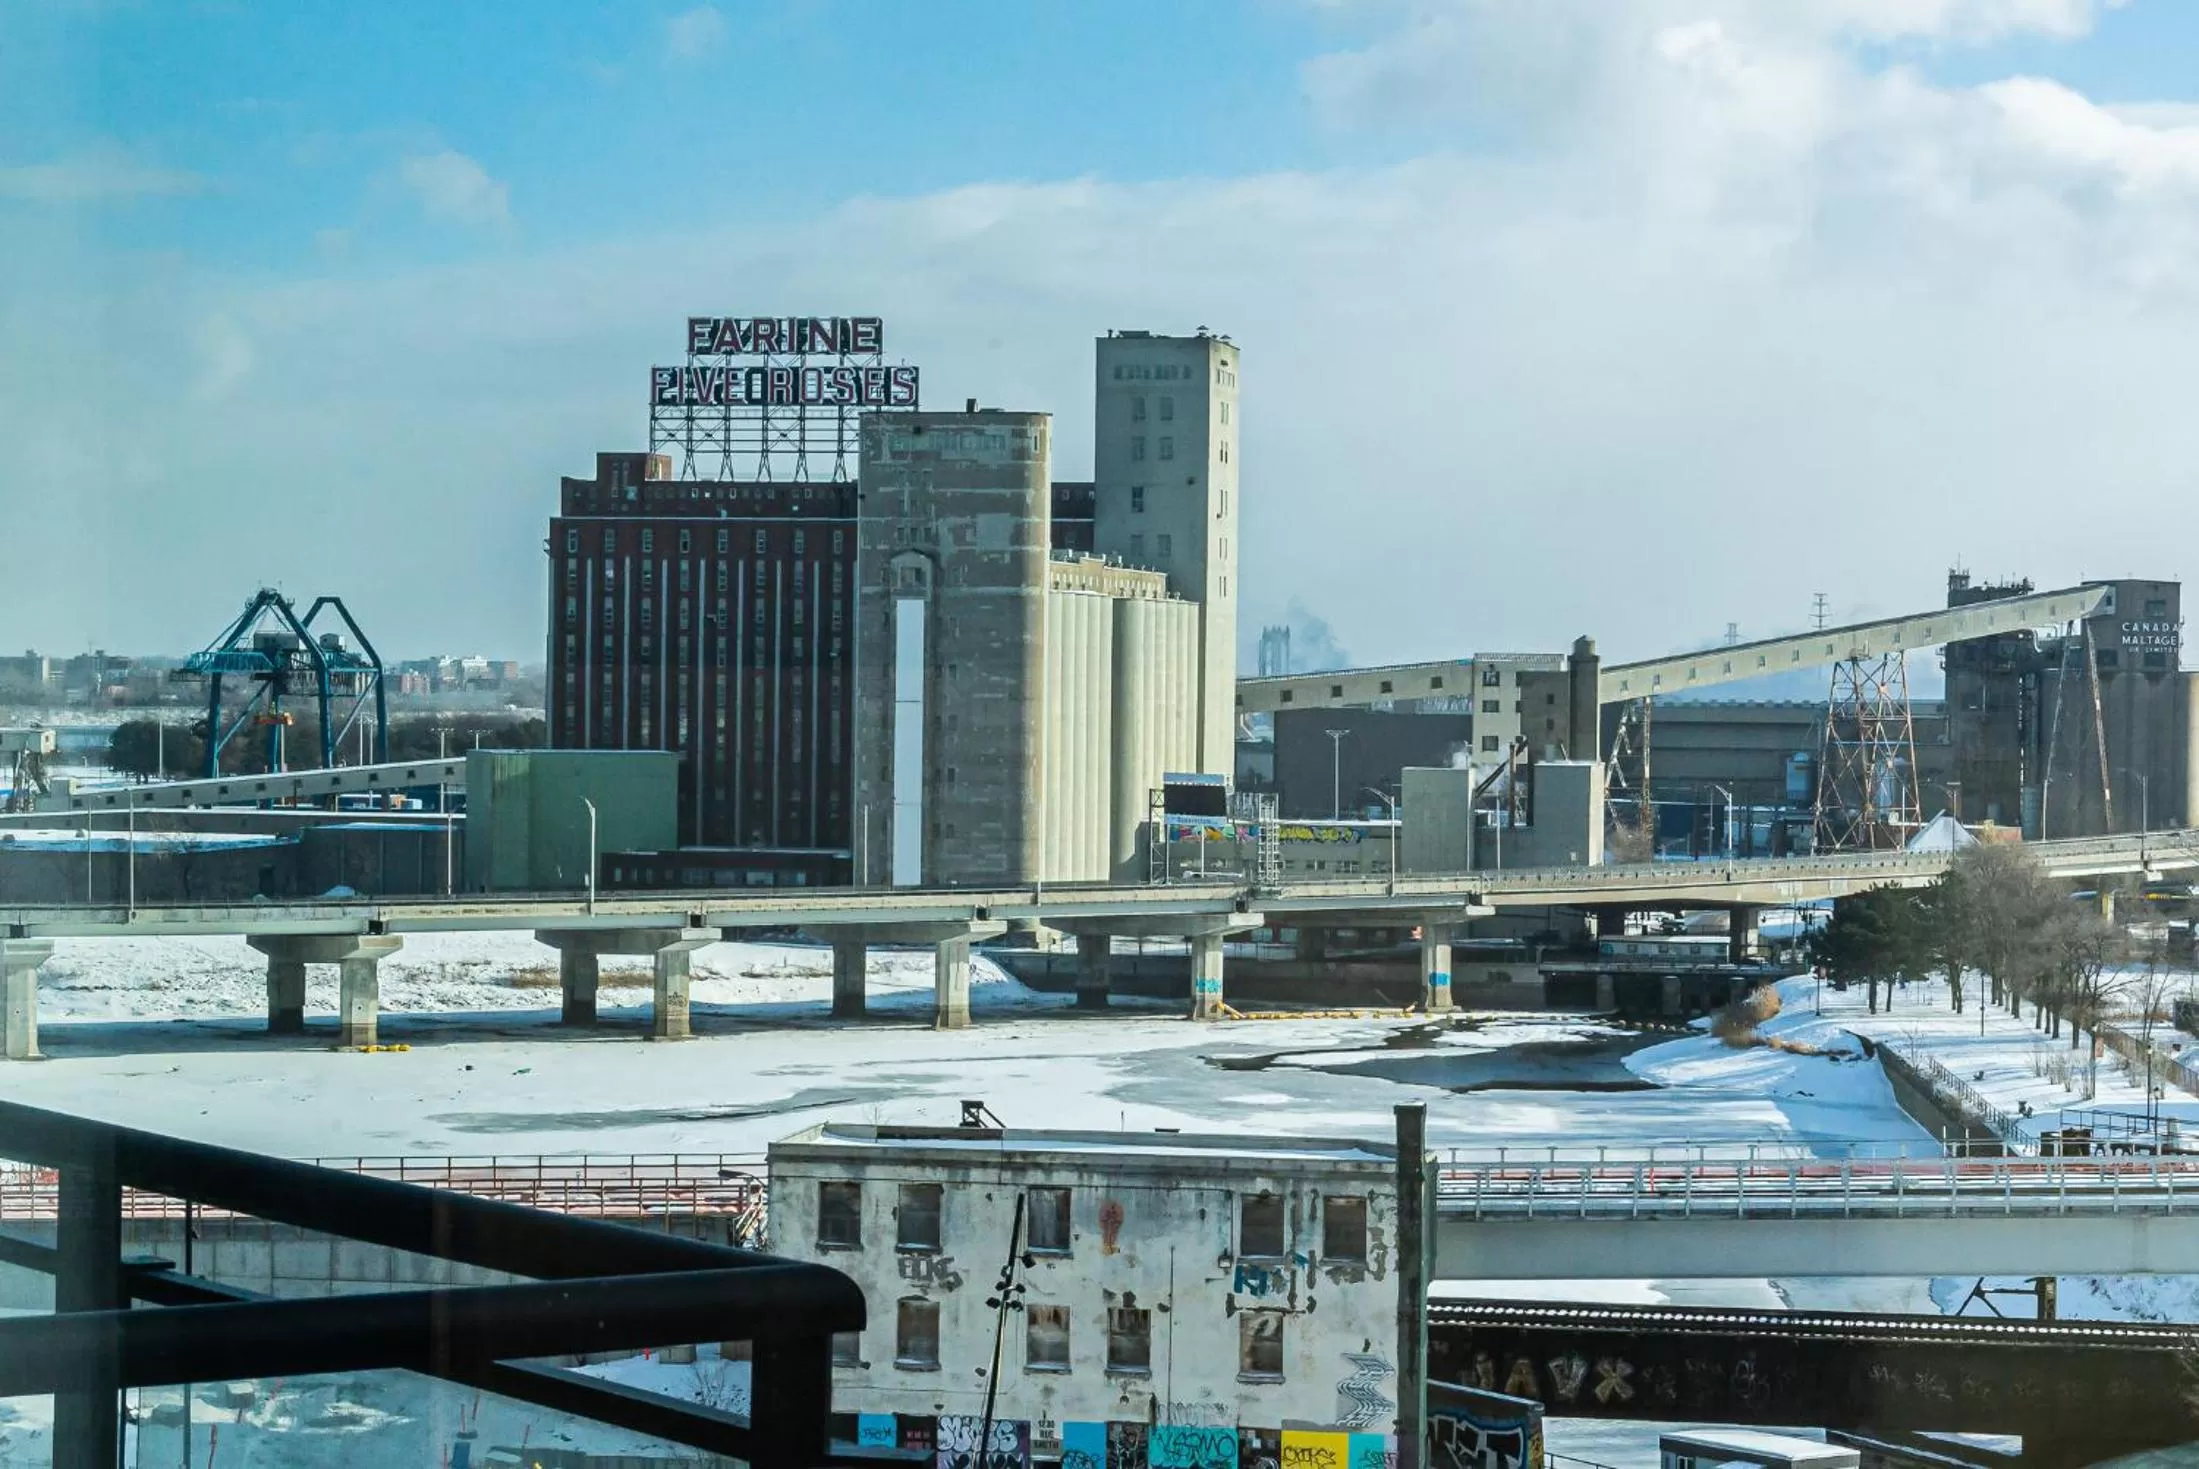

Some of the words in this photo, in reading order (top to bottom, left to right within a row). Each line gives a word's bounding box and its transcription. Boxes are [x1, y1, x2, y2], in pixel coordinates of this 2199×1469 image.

[687, 316, 881, 354] FARINE
[651, 367, 739, 405] FIVE
[768, 366, 916, 405] ROSES
[2122, 622, 2179, 632] CANADA
[2122, 635, 2177, 645] MALTAGE
